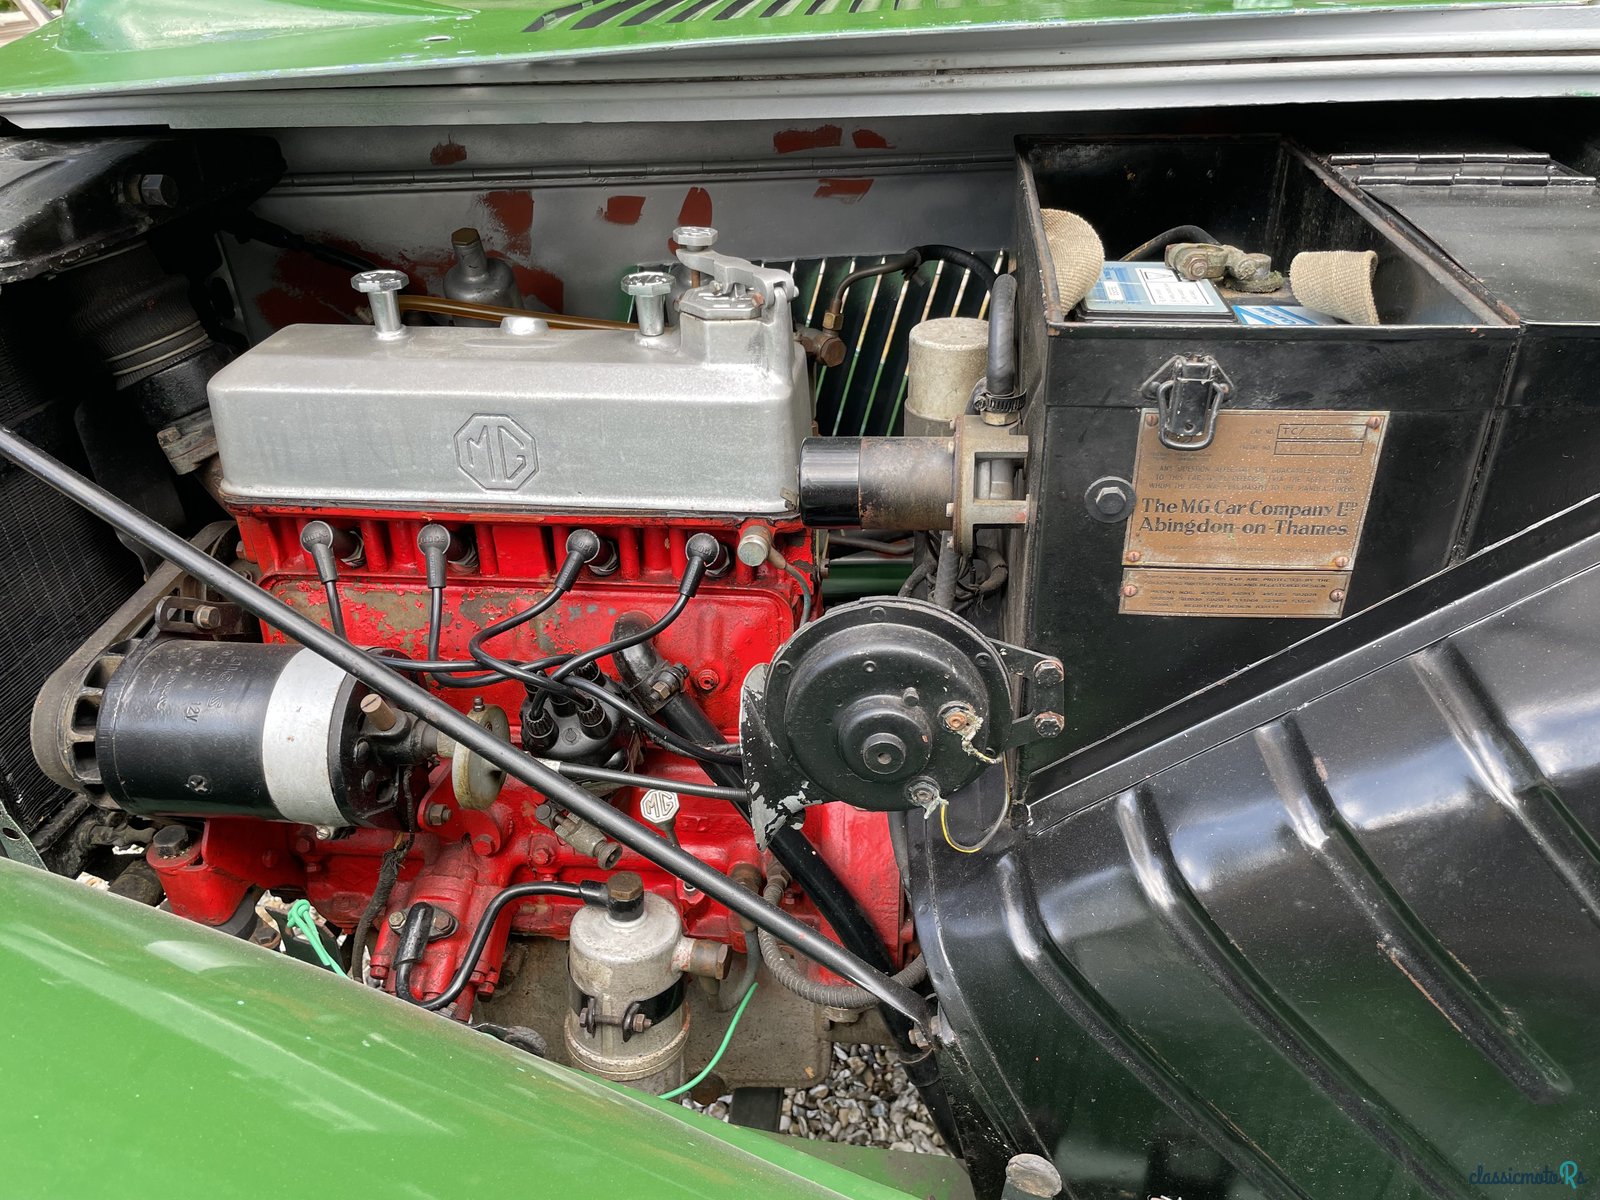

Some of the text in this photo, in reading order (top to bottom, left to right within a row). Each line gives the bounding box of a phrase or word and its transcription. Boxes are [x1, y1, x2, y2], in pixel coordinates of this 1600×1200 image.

[467, 424, 526, 481] MG
[1142, 498, 1178, 513] The
[1214, 499, 1247, 515] Car
[1249, 500, 1333, 519] Company
[646, 793, 674, 818] MG
